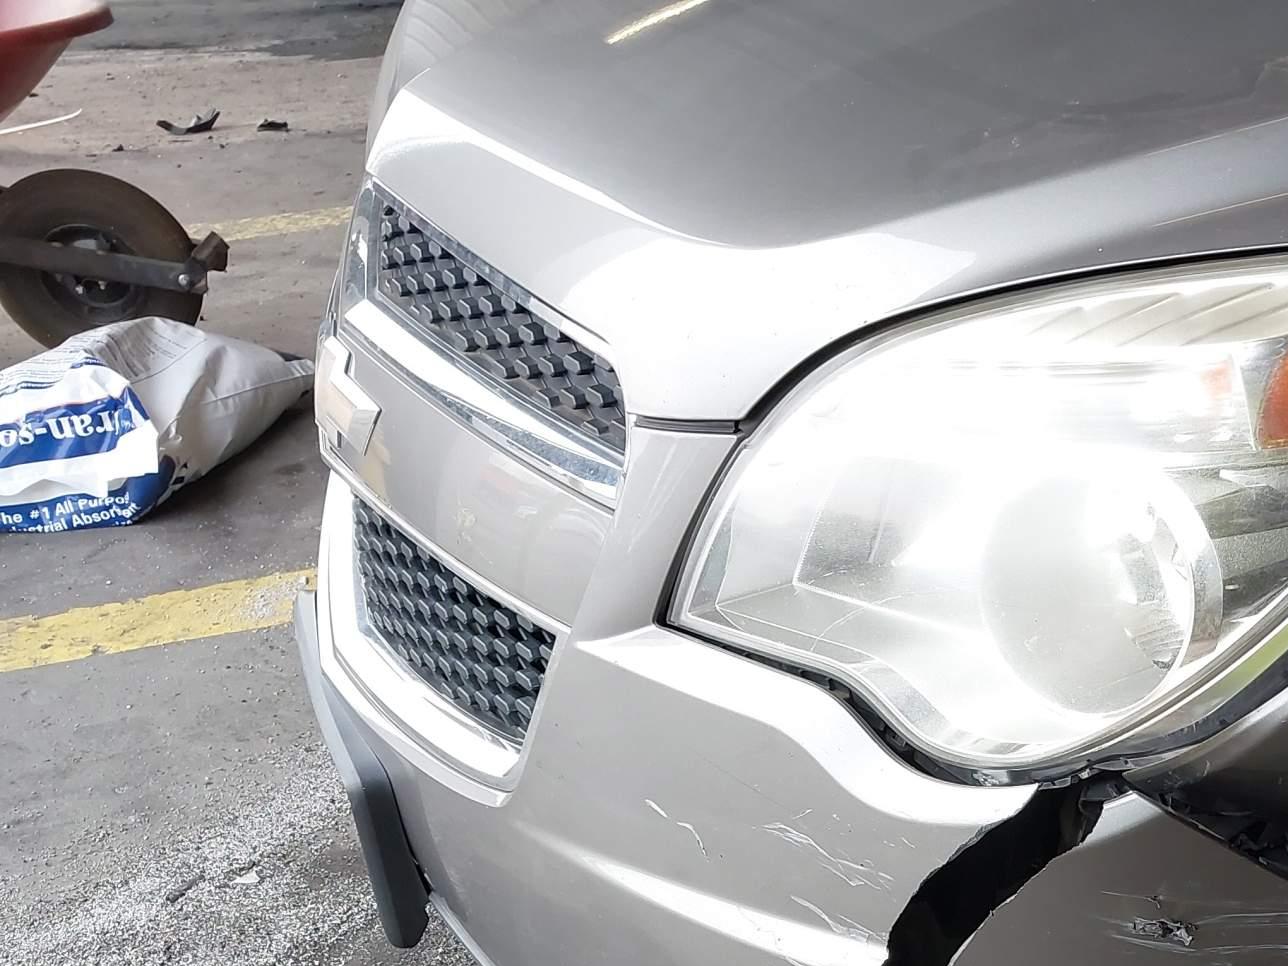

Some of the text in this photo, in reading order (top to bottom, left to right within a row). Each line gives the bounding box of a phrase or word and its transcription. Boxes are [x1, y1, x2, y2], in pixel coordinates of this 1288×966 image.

[0, 511, 23, 525] he
[29, 506, 51, 520] #1
[55, 498, 74, 516] All
